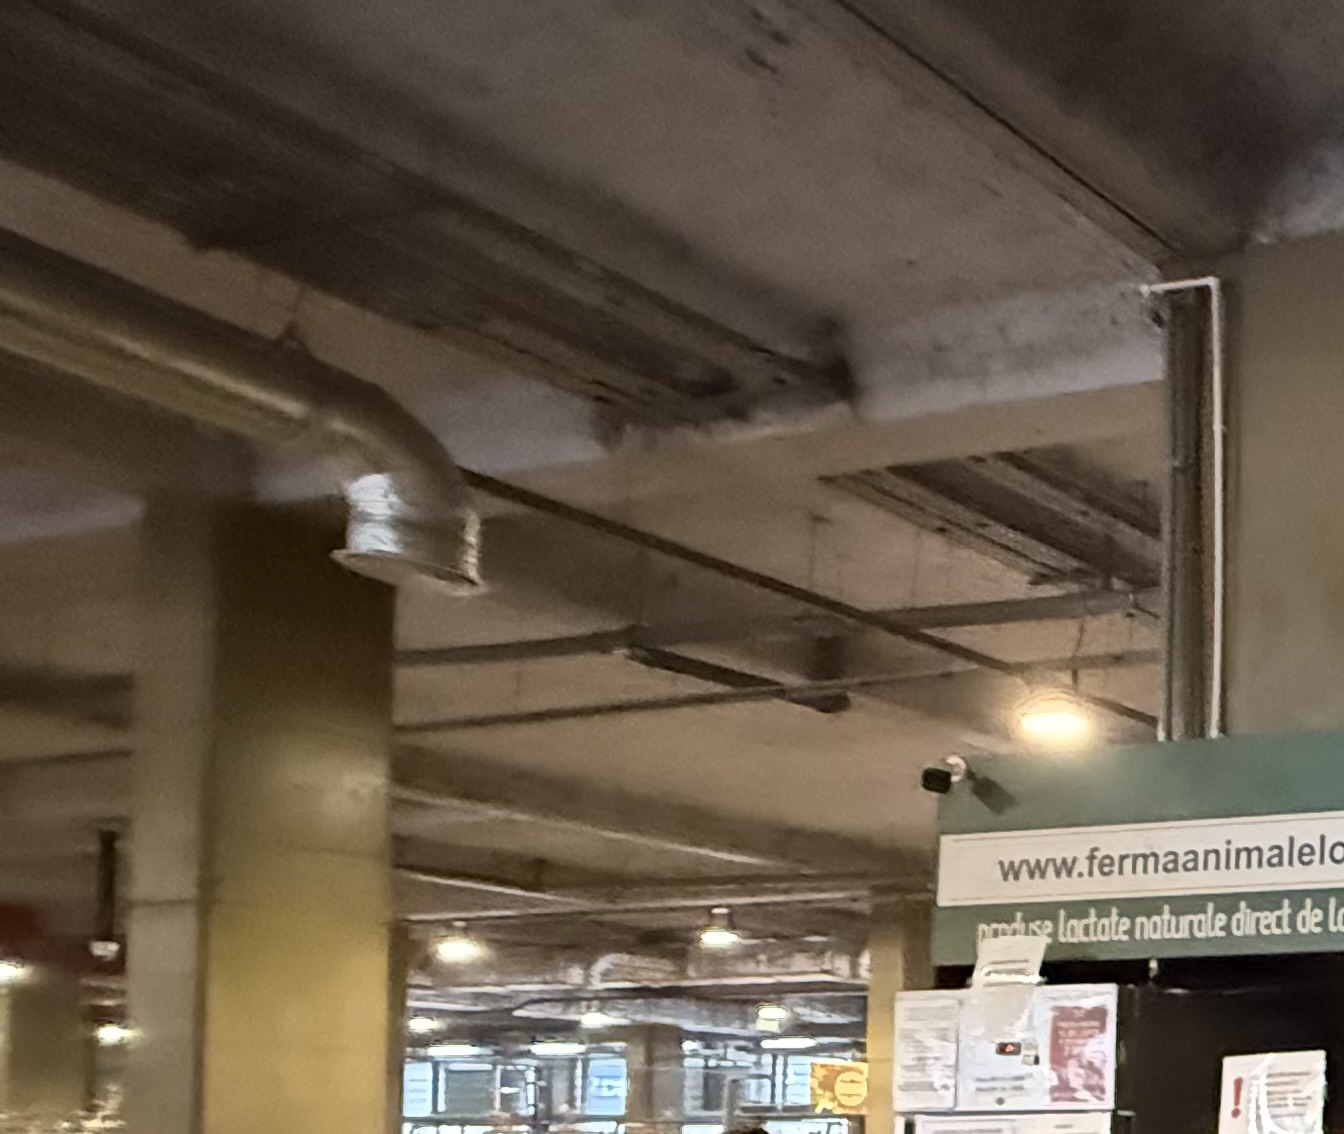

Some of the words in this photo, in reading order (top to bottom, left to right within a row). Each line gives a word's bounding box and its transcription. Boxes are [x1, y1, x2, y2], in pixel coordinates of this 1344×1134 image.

[1058, 906, 1131, 943] lactate
[1135, 903, 1228, 941] naturale
[1231, 900, 1293, 937] direct
[1297, 897, 1325, 934] de
